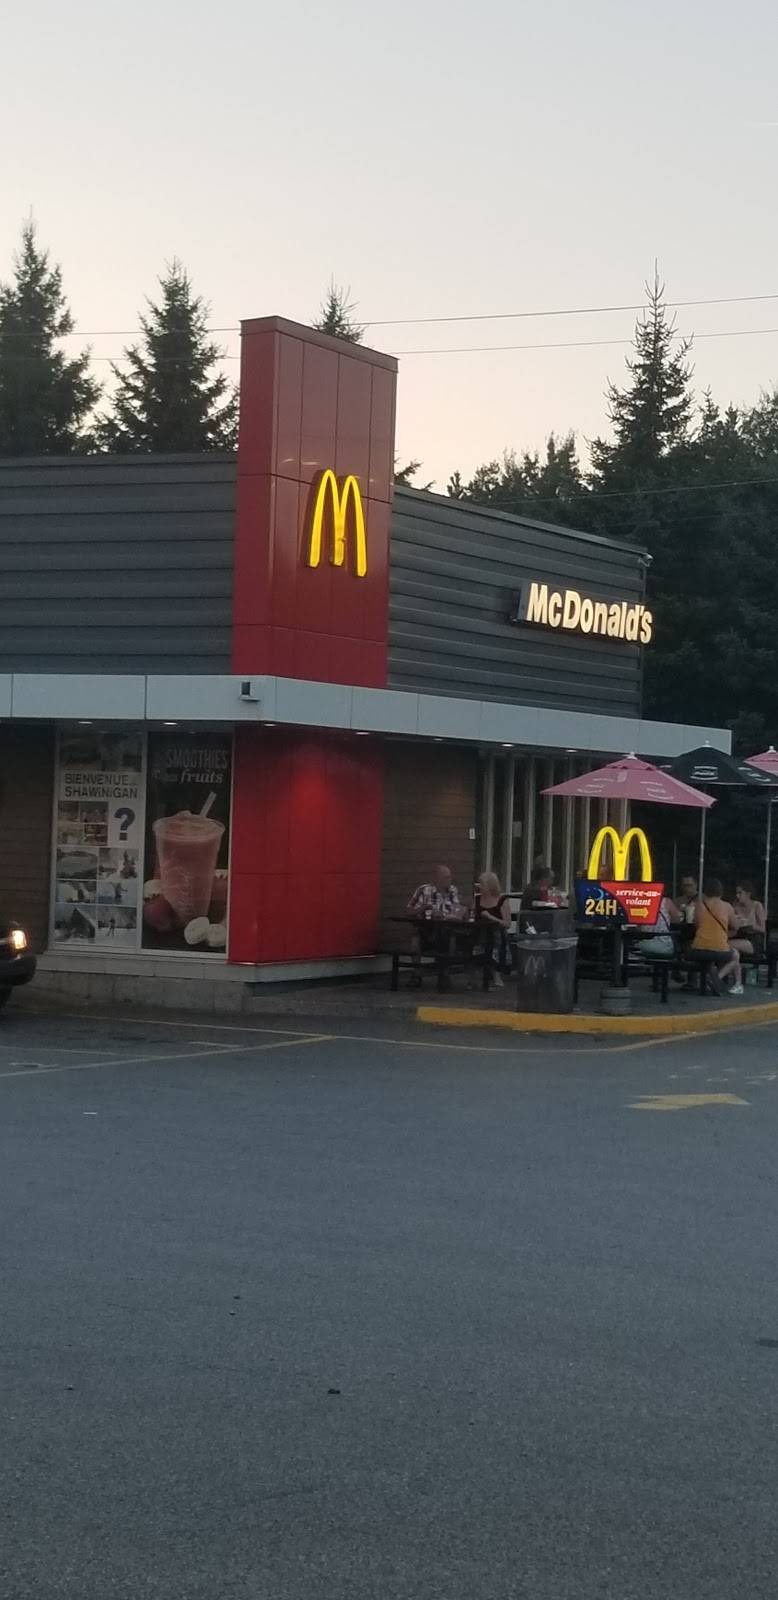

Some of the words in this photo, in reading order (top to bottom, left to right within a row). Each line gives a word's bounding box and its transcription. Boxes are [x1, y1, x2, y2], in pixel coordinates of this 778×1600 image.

[526, 582, 653, 644] McDonald's
[167, 748, 229, 769] SMOOTHIES
[179, 768, 224, 785] fruits
[584, 898, 617, 916] 24H
[625, 898, 651, 906] volant
